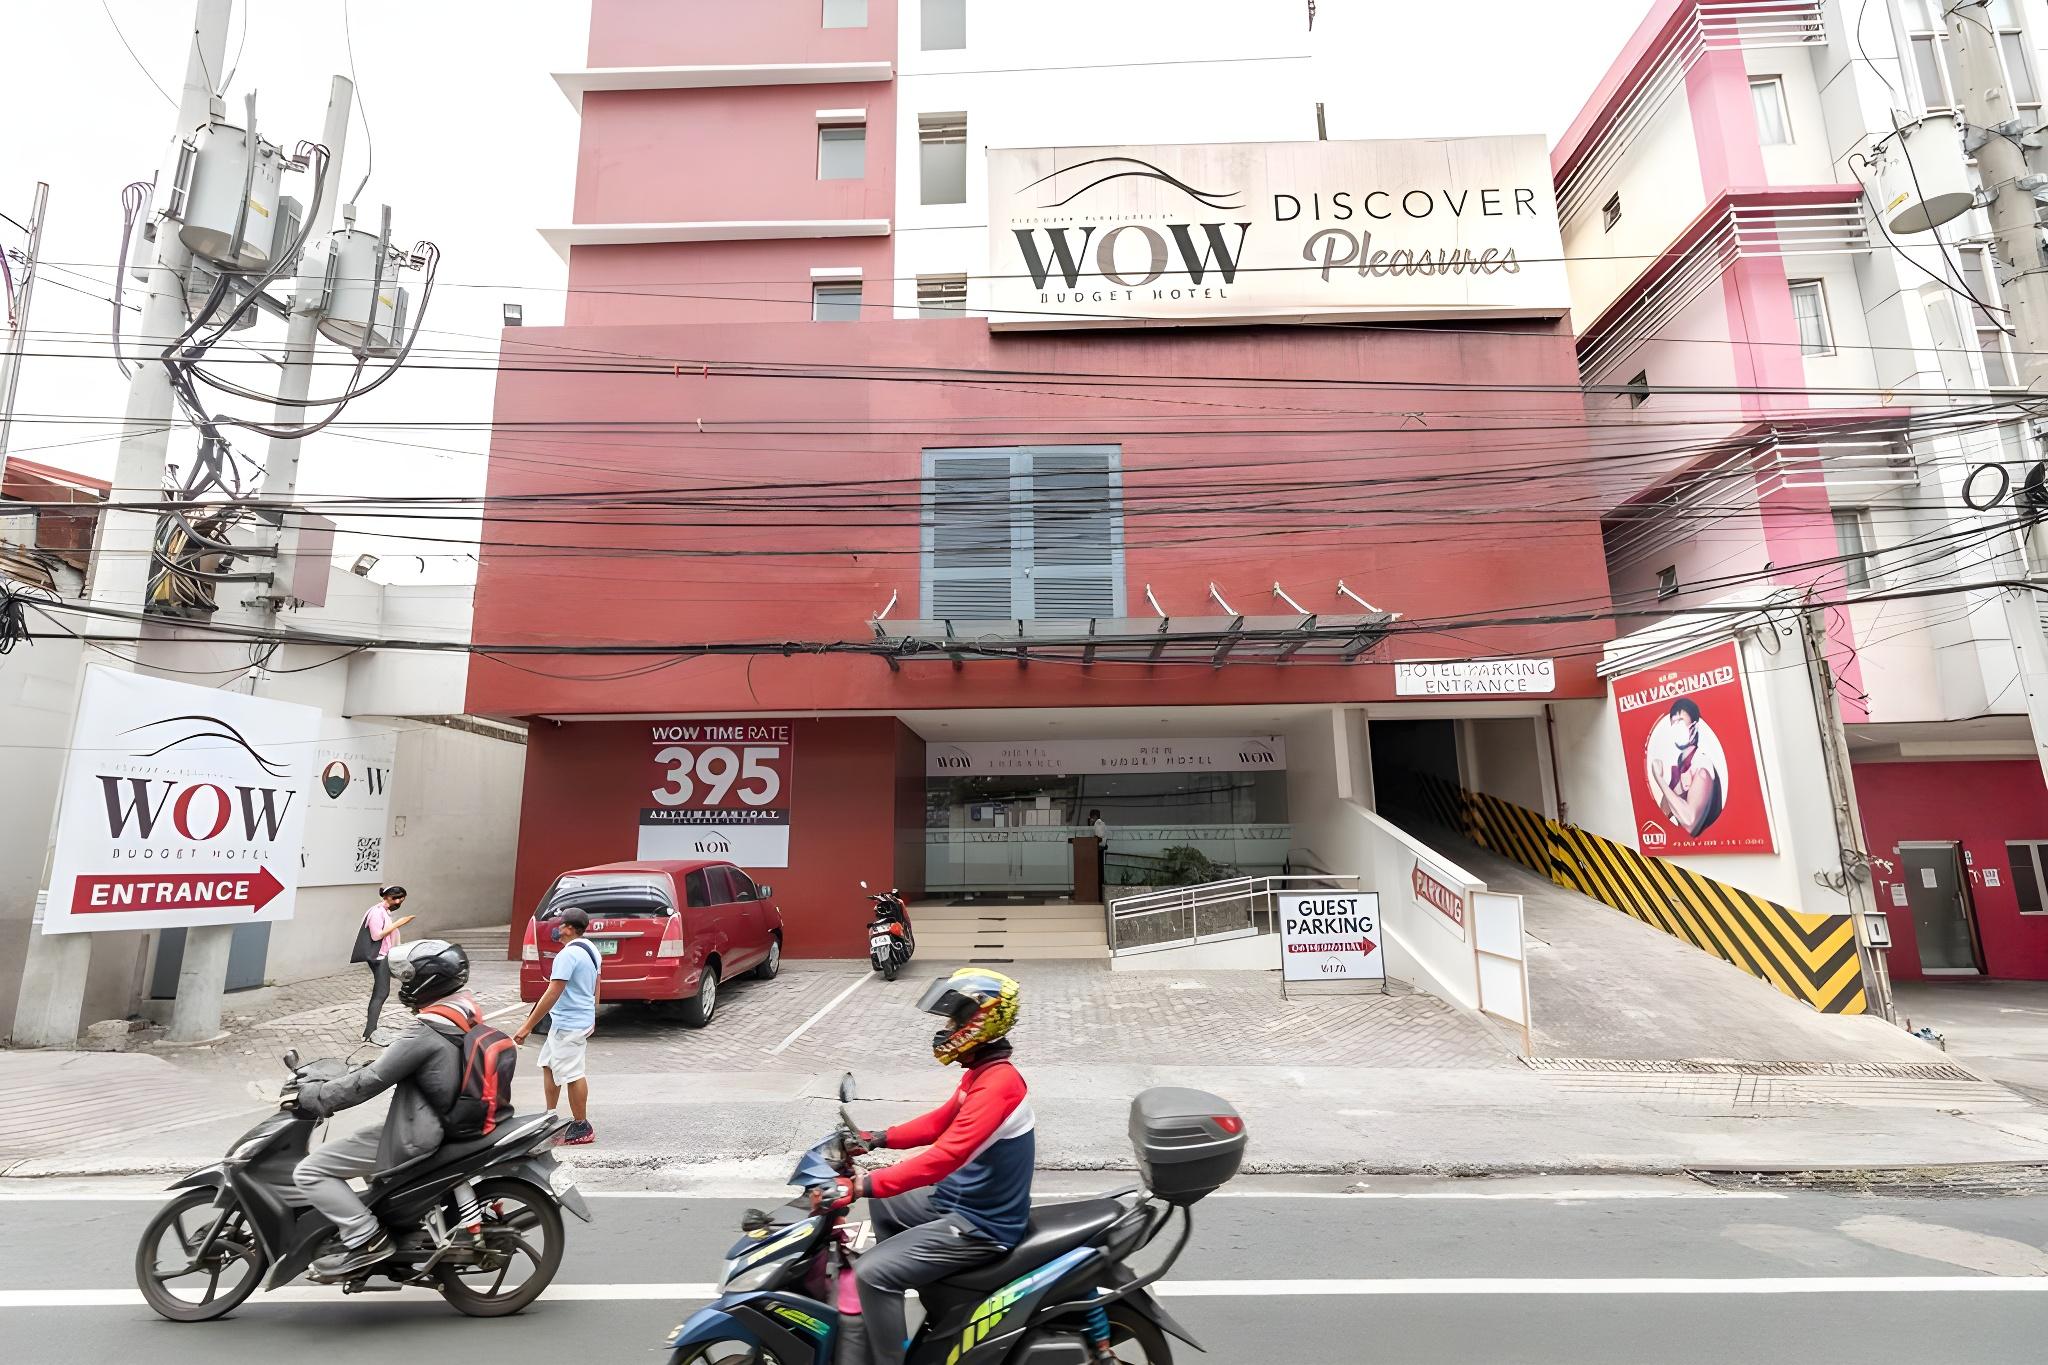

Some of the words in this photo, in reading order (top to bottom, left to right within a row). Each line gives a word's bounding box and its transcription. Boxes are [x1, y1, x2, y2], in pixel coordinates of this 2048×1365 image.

[1274, 188, 1537, 222] DISCOVER
[1011, 222, 1252, 290] WOW
[1302, 228, 1521, 283] Pleasures
[1040, 290, 1134, 304] BUDGET
[1152, 288, 1228, 300] HOTEL
[1400, 663, 1462, 678] HOTEL
[1425, 678, 1528, 694] ENTRANCE
[1649, 665, 1734, 700] VACCINATED
[652, 726, 700, 740] WOW
[703, 726, 744, 740] TIME
[748, 726, 789, 740] RATE
[651, 746, 780, 806] 395
[95, 775, 297, 842] WOW
[112, 848, 196, 860] BUDGET
[90, 880, 250, 906] ENTRANCE
[1298, 898, 1358, 917] GUEST
[1286, 916, 1373, 935] PARKING
